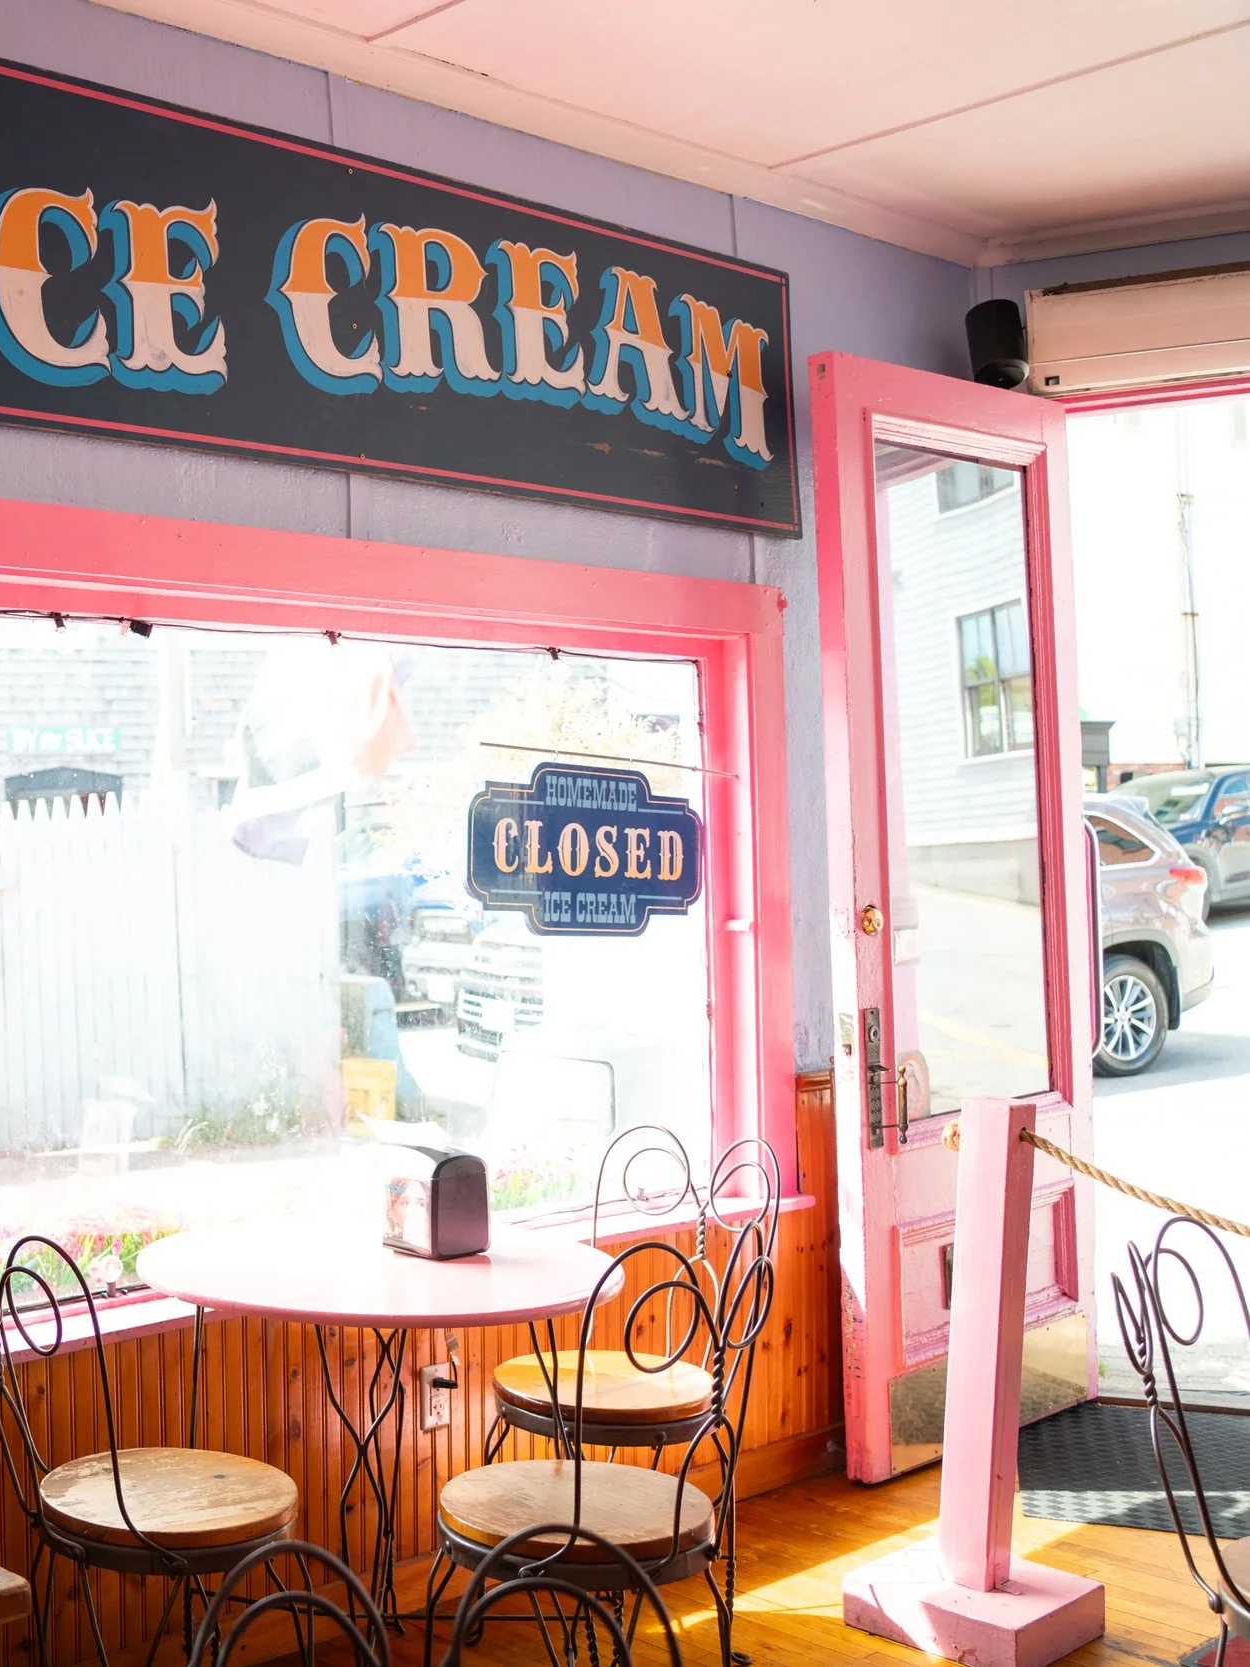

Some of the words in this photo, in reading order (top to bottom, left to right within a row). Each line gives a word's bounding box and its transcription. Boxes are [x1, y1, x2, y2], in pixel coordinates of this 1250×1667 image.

[265, 212, 776, 470] CREAM
[545, 775, 638, 812] HOMEMADE
[492, 817, 684, 881] CLOSED
[543, 890, 572, 923] ICE
[575, 893, 637, 925] CREAM
